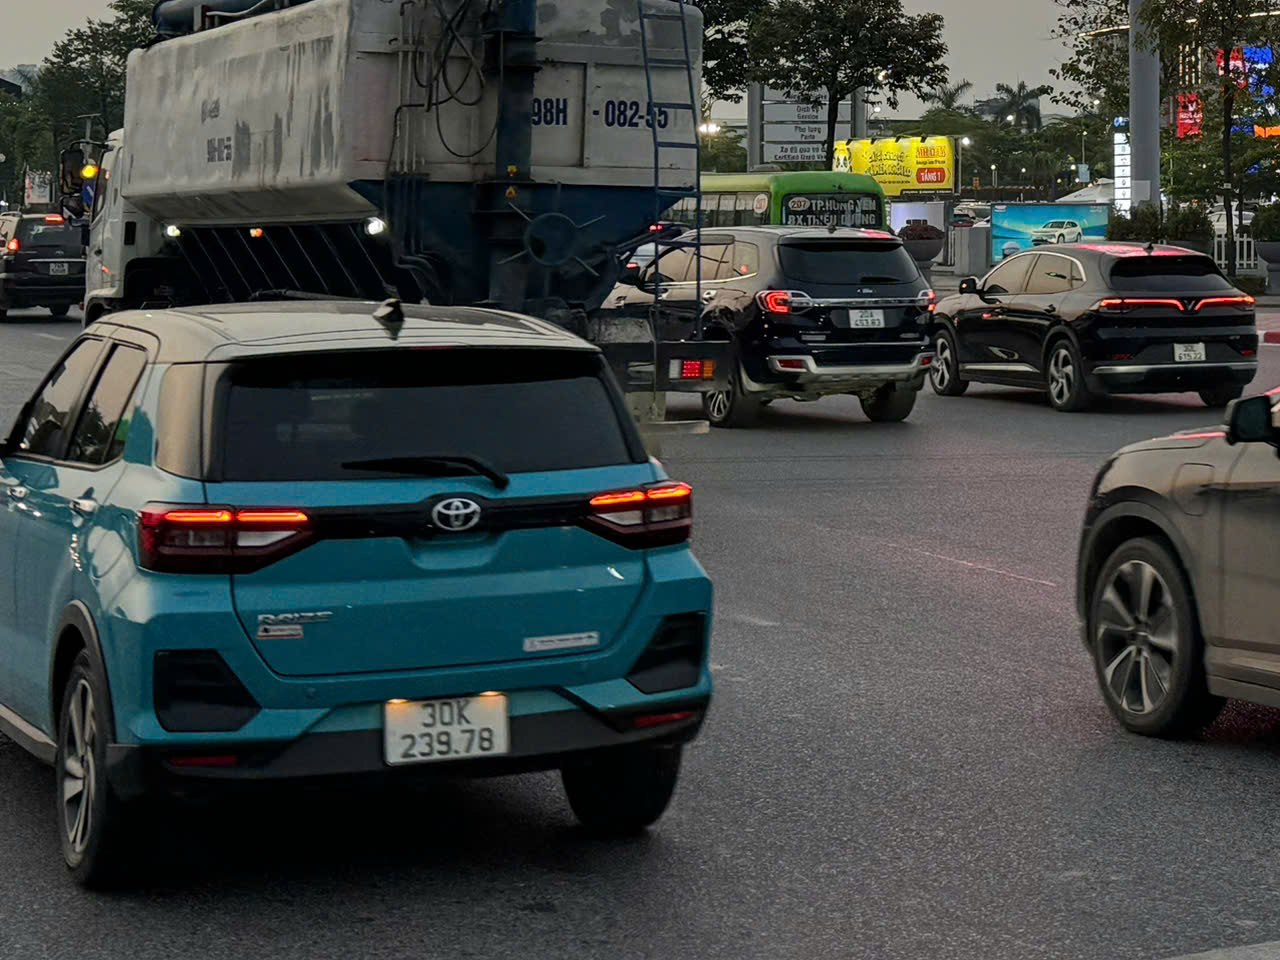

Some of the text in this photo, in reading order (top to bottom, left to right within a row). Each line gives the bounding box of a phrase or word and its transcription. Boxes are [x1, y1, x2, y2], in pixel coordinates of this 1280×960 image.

[531, 98, 568, 126] 98H
[421, 698, 471, 728] 30K
[401, 728, 495, 759] 239.78
